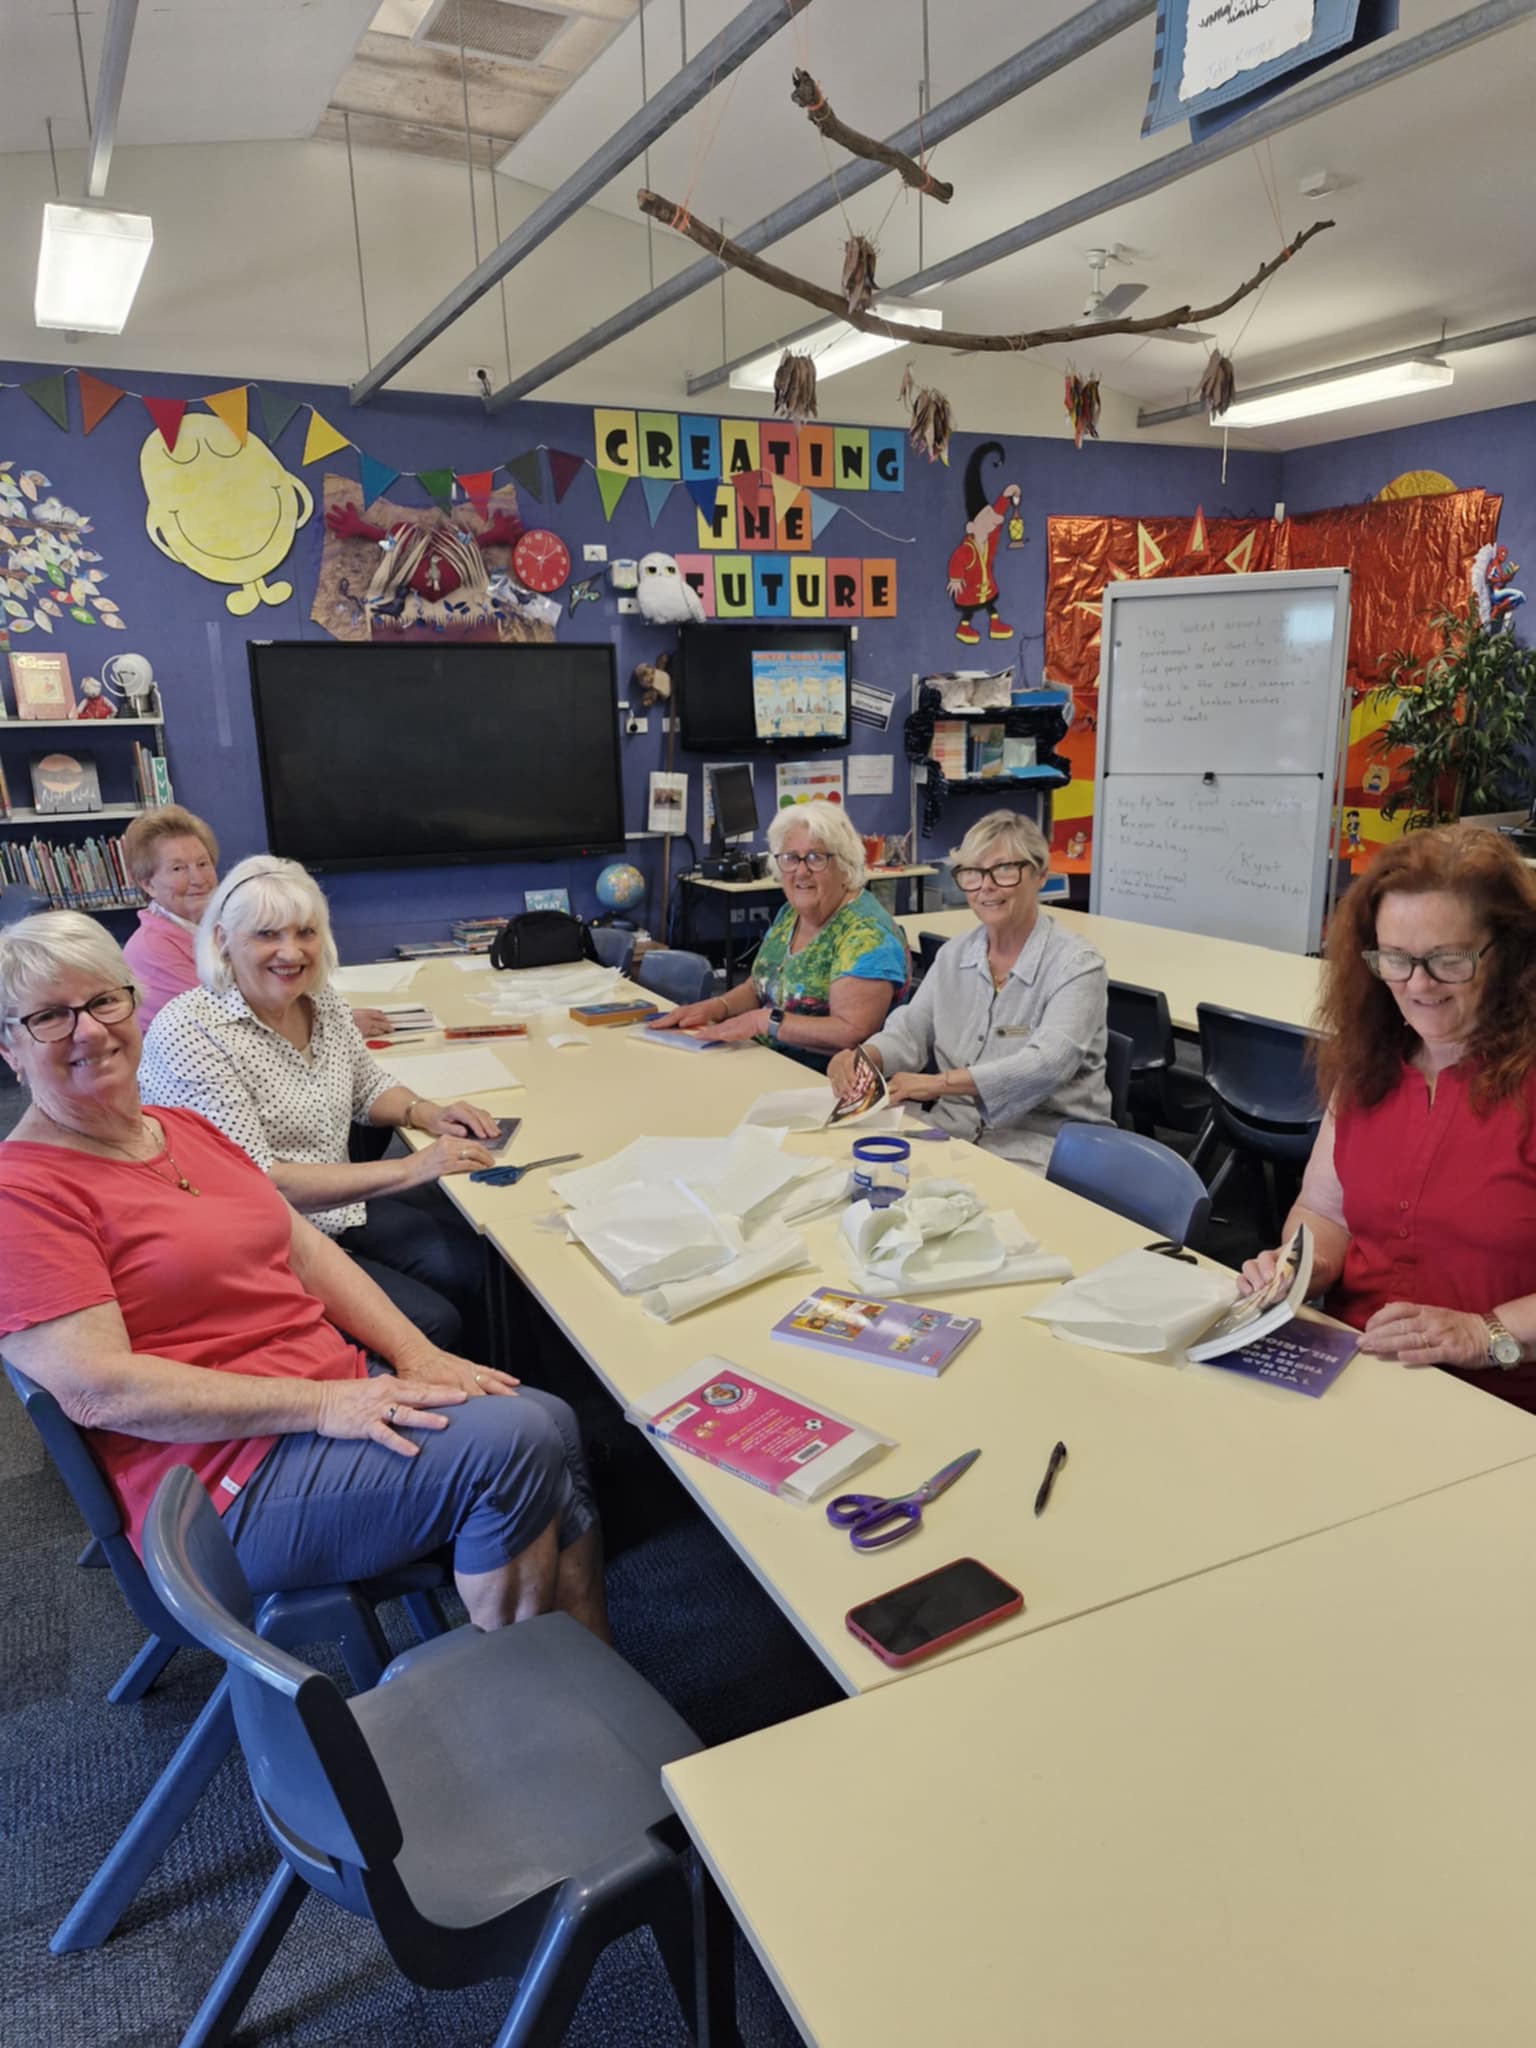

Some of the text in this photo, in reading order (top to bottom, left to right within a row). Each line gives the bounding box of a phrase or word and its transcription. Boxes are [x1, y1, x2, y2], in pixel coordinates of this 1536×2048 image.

[605, 428, 899, 483] CREATING
[711, 504, 804, 541] THE
[684, 572, 890, 608] FUTURE
[1259, 1367, 1299, 1384] WISH
